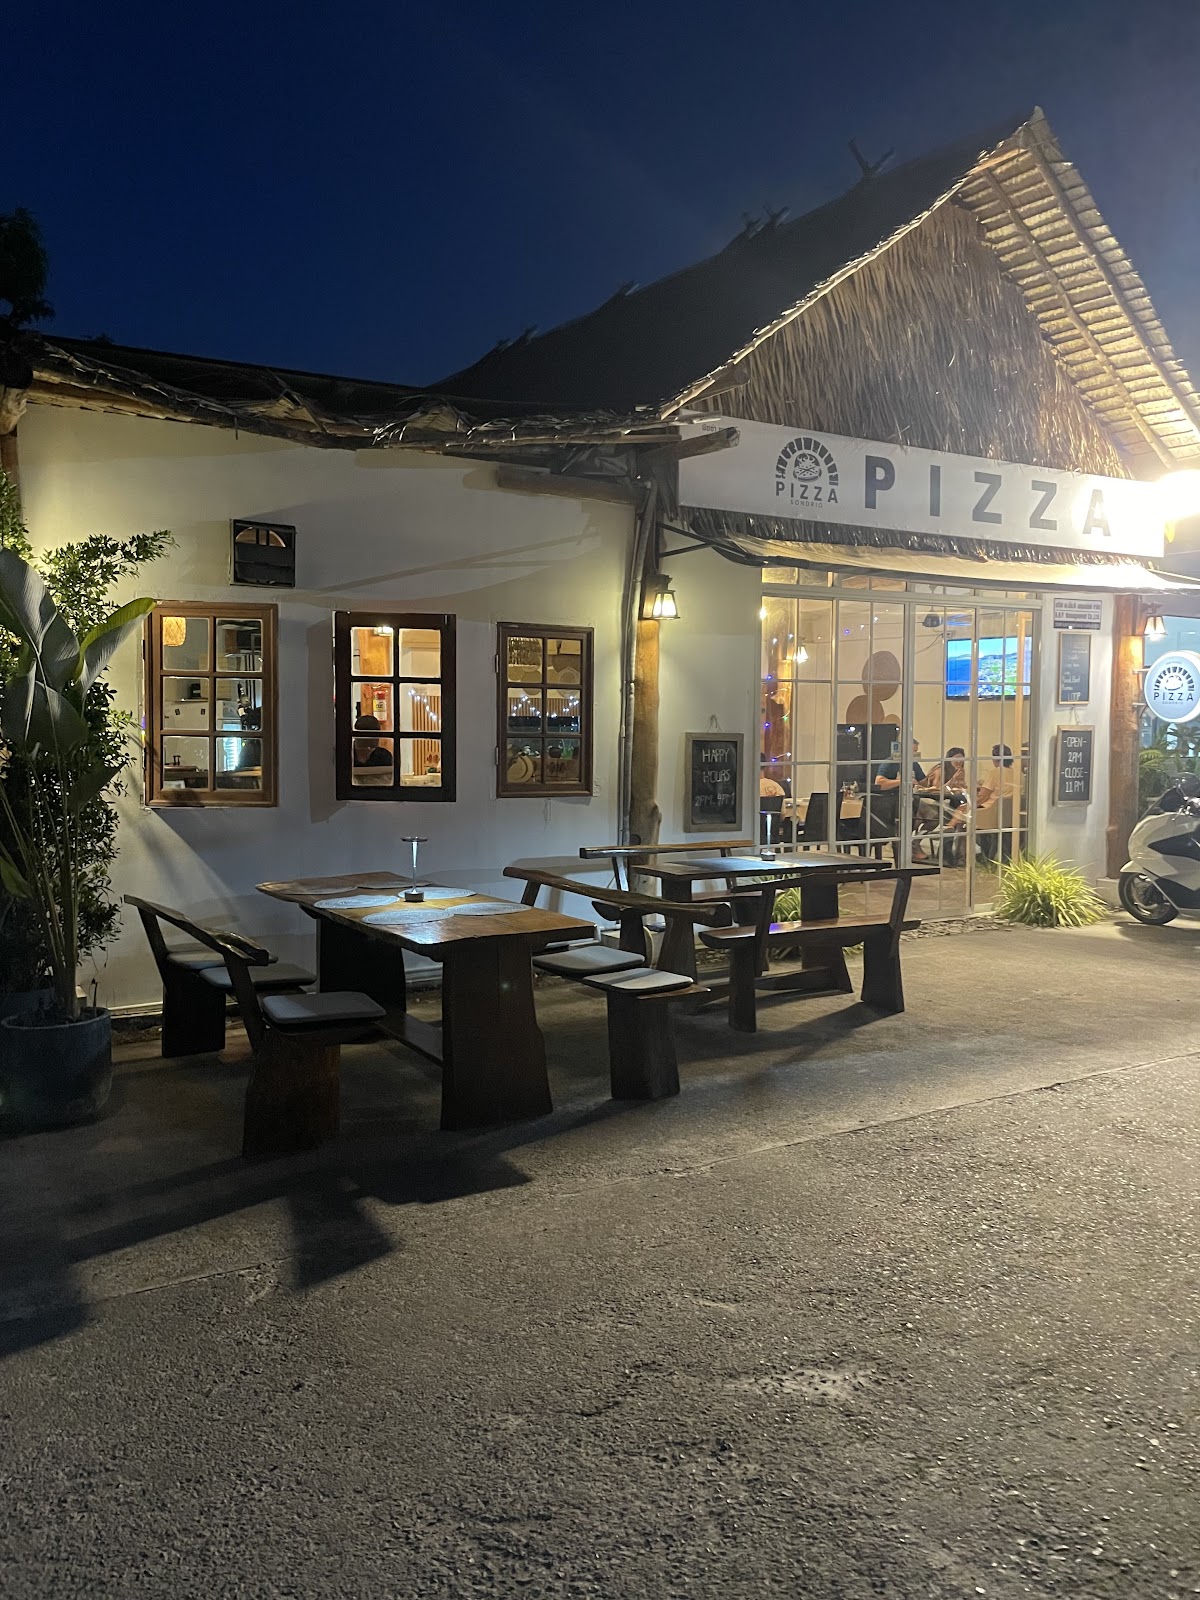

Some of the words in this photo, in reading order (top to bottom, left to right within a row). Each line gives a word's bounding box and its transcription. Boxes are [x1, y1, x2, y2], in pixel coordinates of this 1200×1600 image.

[775, 480, 839, 504] PIZZA
[864, 454, 1112, 537] PIZZA
[789, 499, 823, 509] SONDRIO
[1153, 691, 1194, 701] PIZZA
[702, 748, 730, 763] HAPPY
[1067, 751, 1083, 764] 2PM
[702, 768, 731, 783] HOURS
